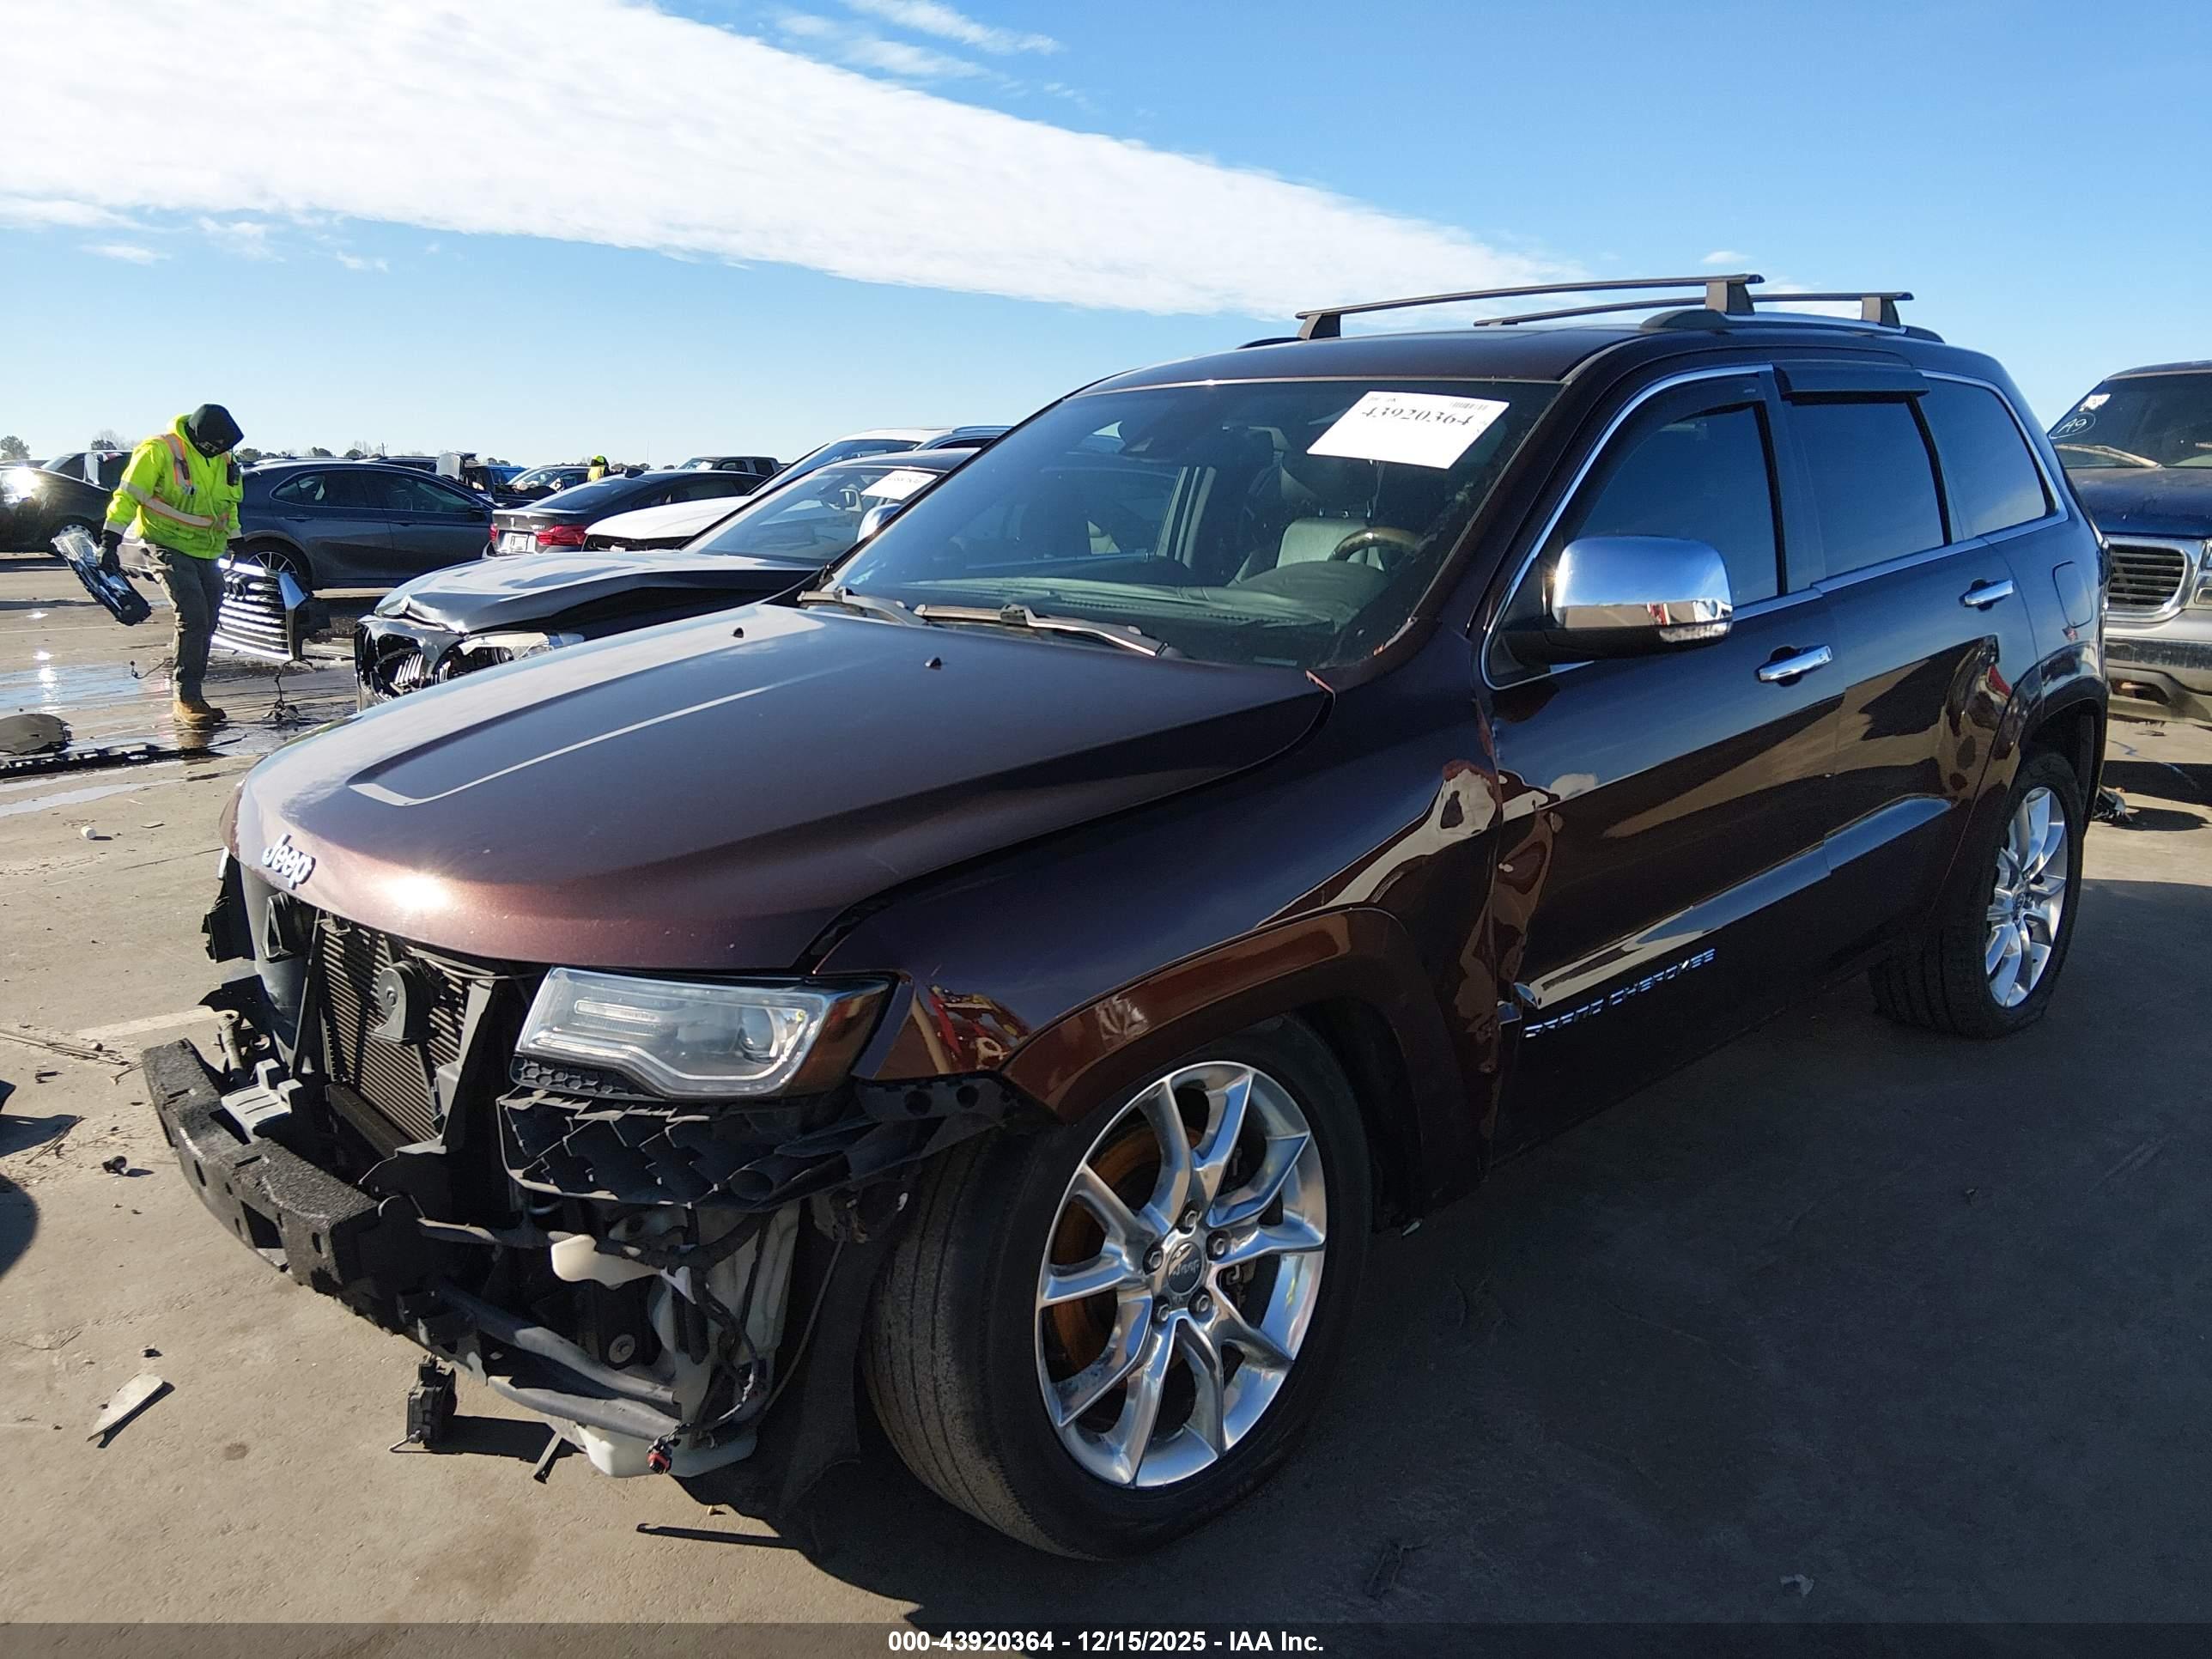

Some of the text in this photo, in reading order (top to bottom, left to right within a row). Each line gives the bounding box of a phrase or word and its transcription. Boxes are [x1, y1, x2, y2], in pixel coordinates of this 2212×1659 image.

[1361, 405, 1476, 427] 43920364
[2057, 417, 2087, 433] A9
[261, 833, 316, 890] Jeep
[1608, 947, 1717, 1006] CHEROKEE
